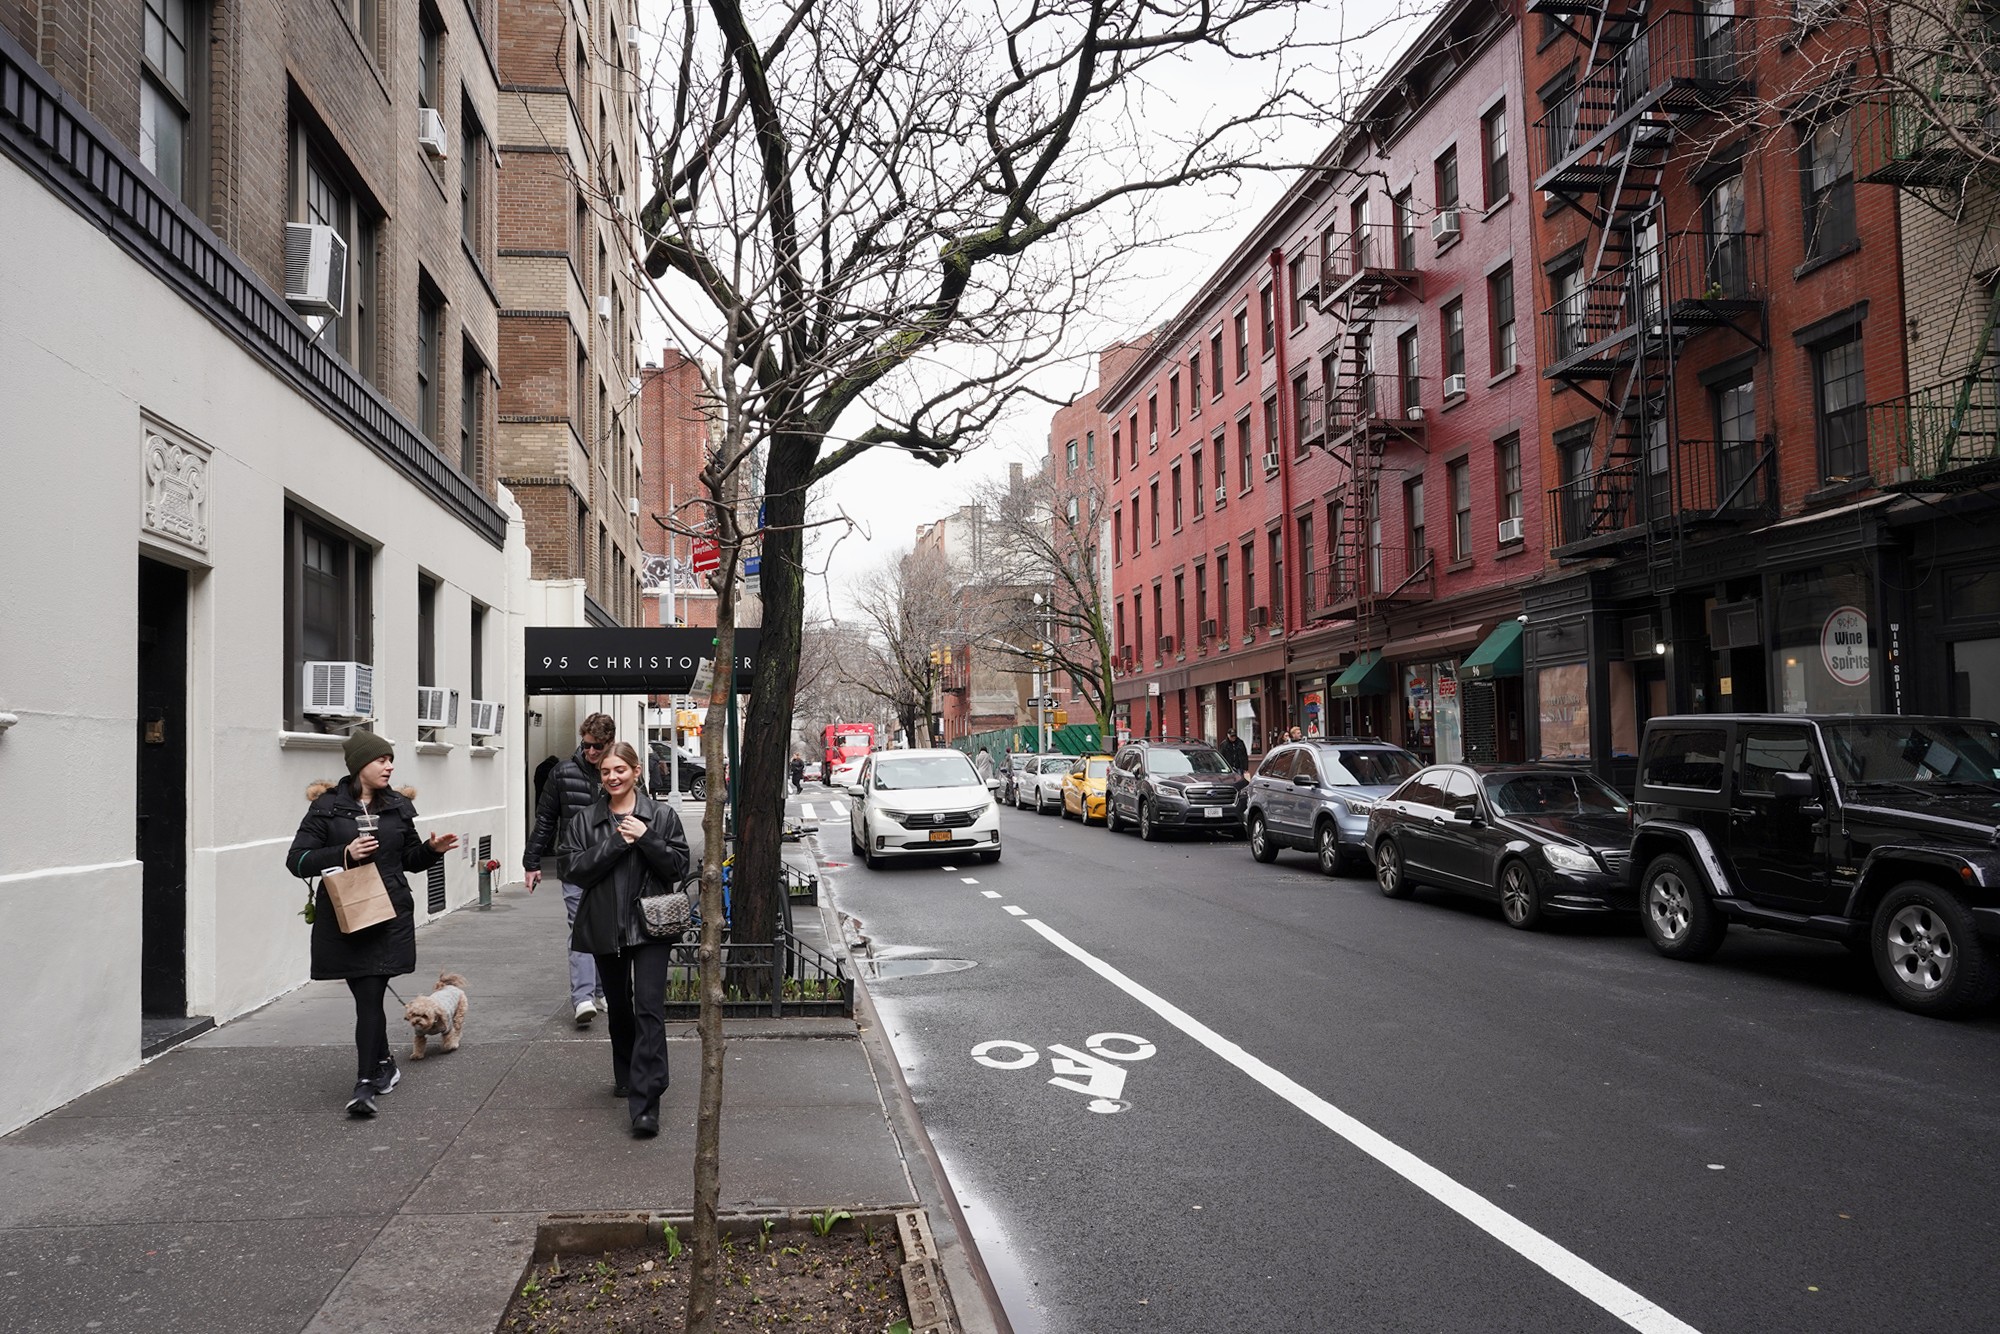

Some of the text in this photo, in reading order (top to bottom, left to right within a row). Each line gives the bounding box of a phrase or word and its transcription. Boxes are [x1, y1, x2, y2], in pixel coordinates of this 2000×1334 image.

[1834, 631, 1863, 645] Wine
[1890, 623, 1899, 656] Wine
[1846, 646, 1853, 655] &
[543, 656, 568, 669] 95
[1831, 655, 1869, 670] Spirits
[1472, 666, 1480, 676] 96
[1341, 685, 1348, 694] 94
